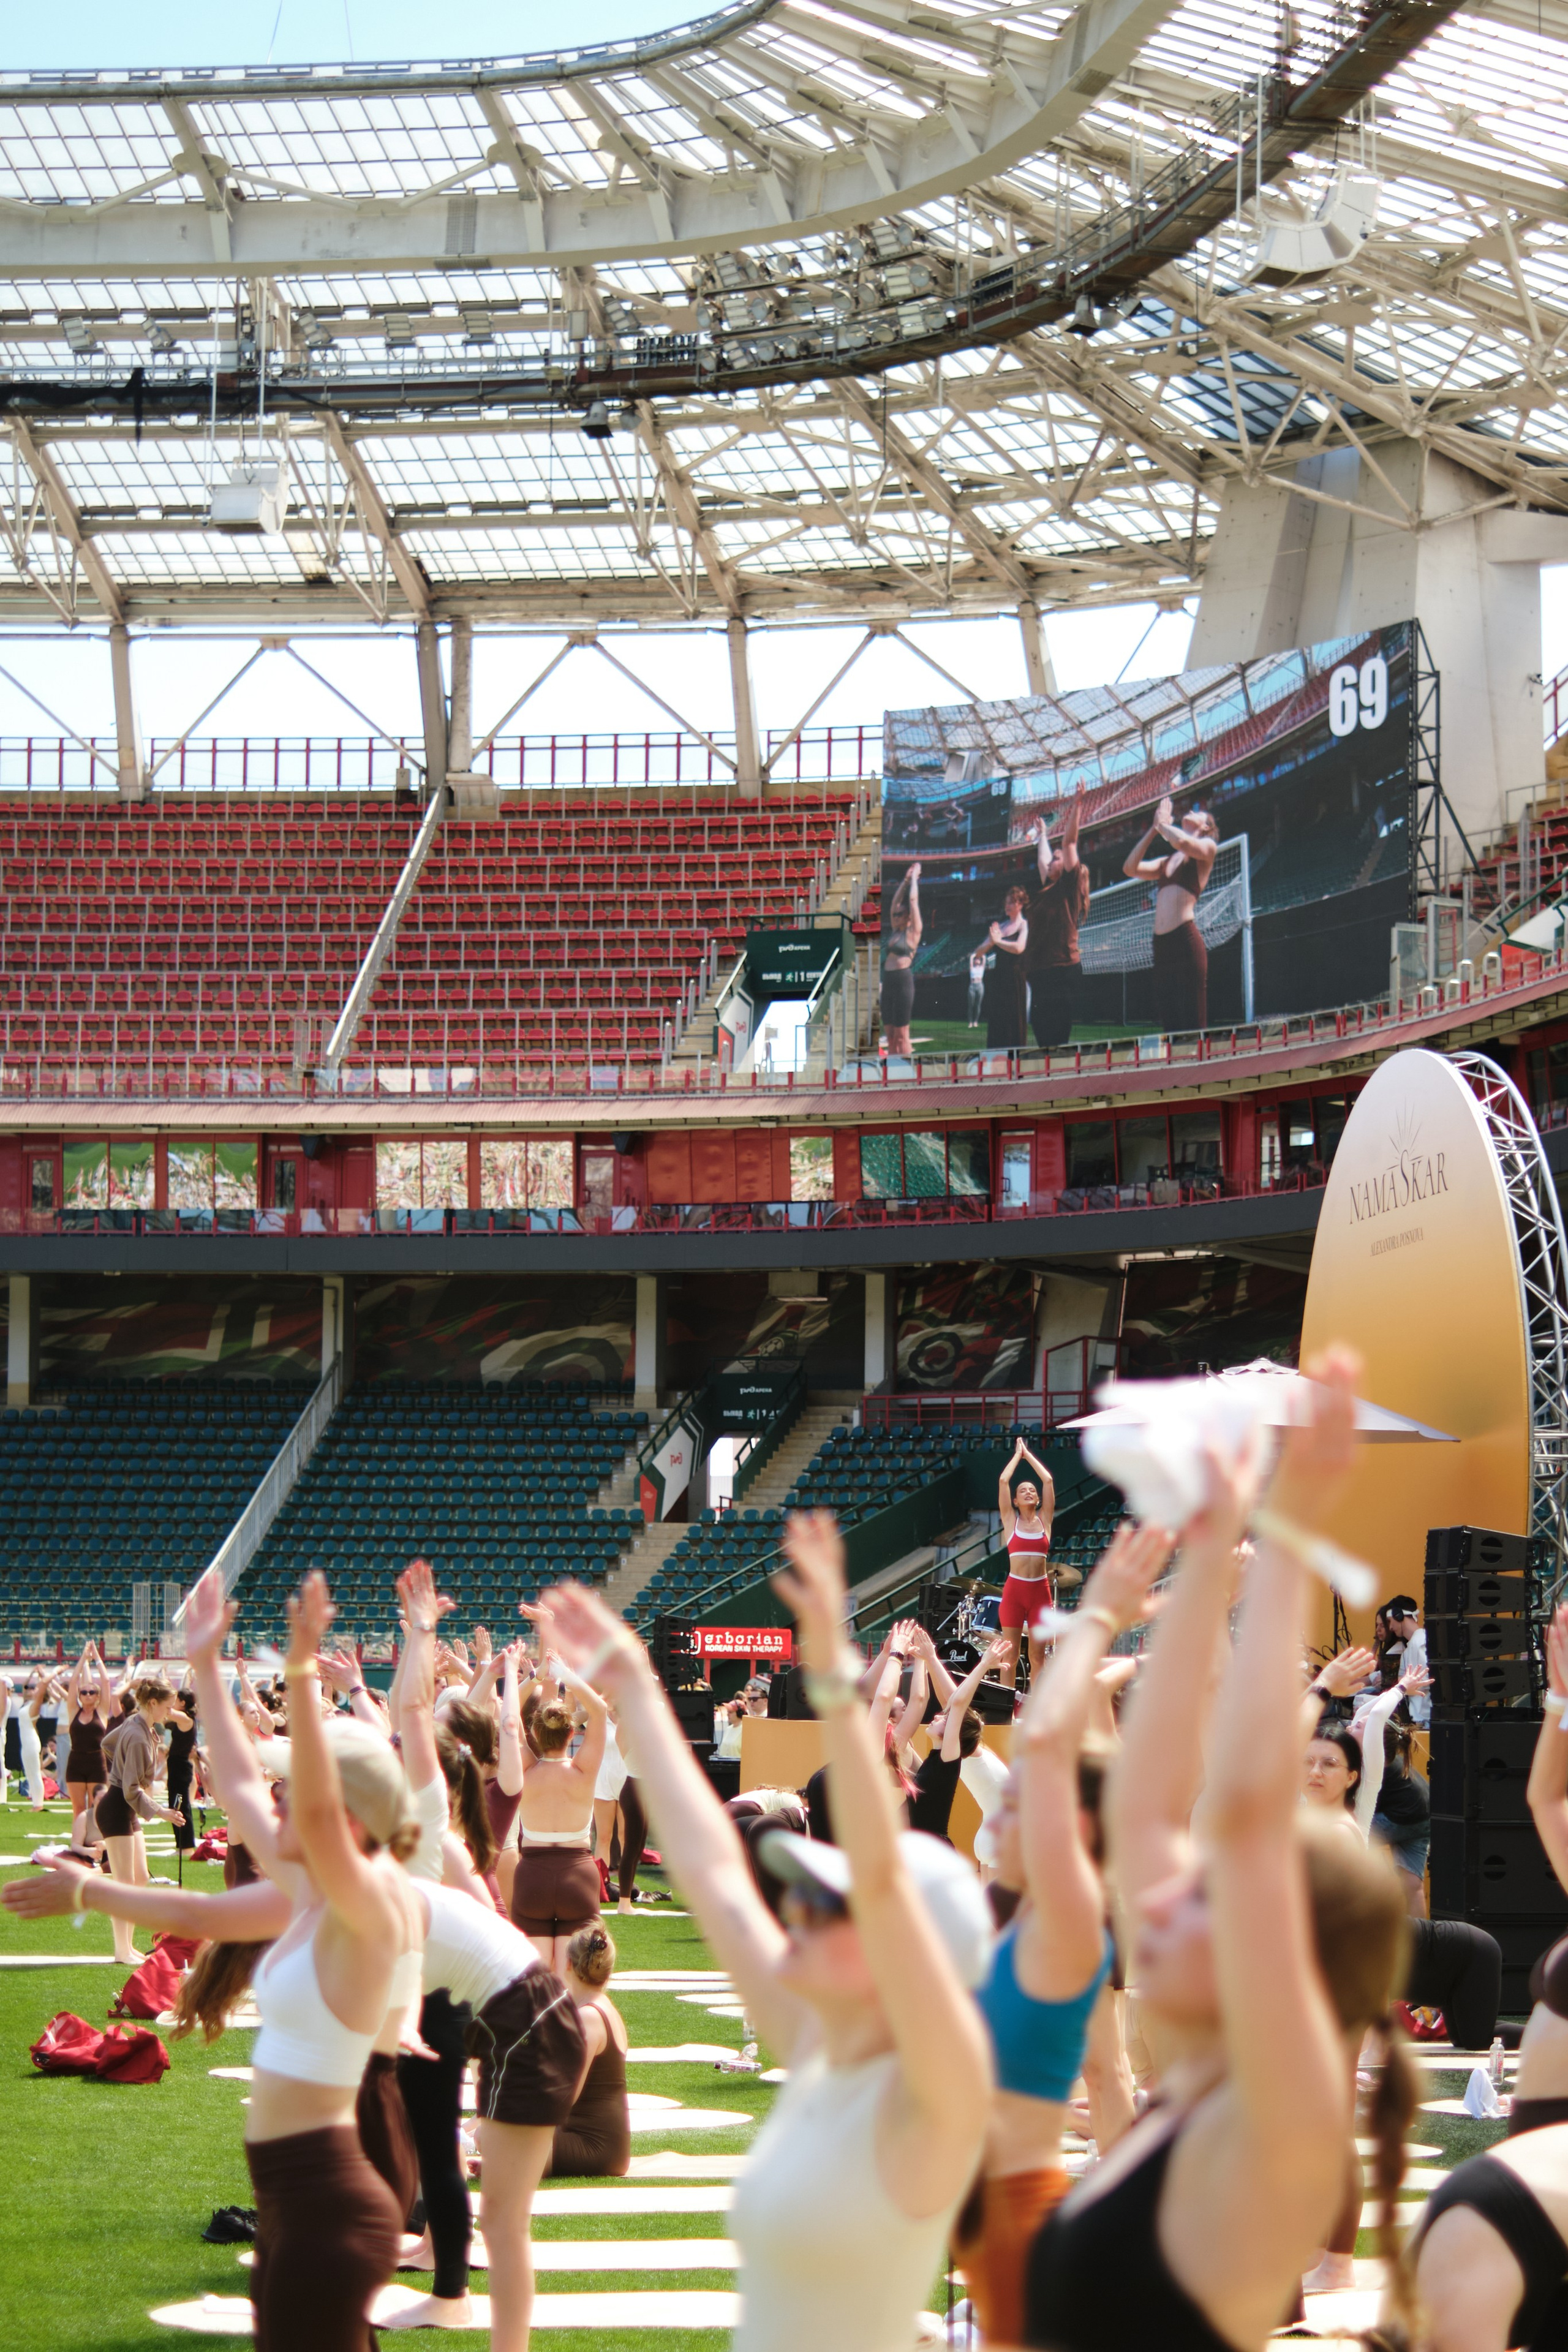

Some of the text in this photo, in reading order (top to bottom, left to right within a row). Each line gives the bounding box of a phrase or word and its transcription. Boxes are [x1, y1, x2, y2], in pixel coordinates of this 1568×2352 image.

[1329, 657, 1388, 737] 69
[1370, 1227, 1423, 1257] ALEXANDRA POSNOVA
[704, 1632, 783, 1645] erborian
[949, 1649, 968, 1661] Pearl
